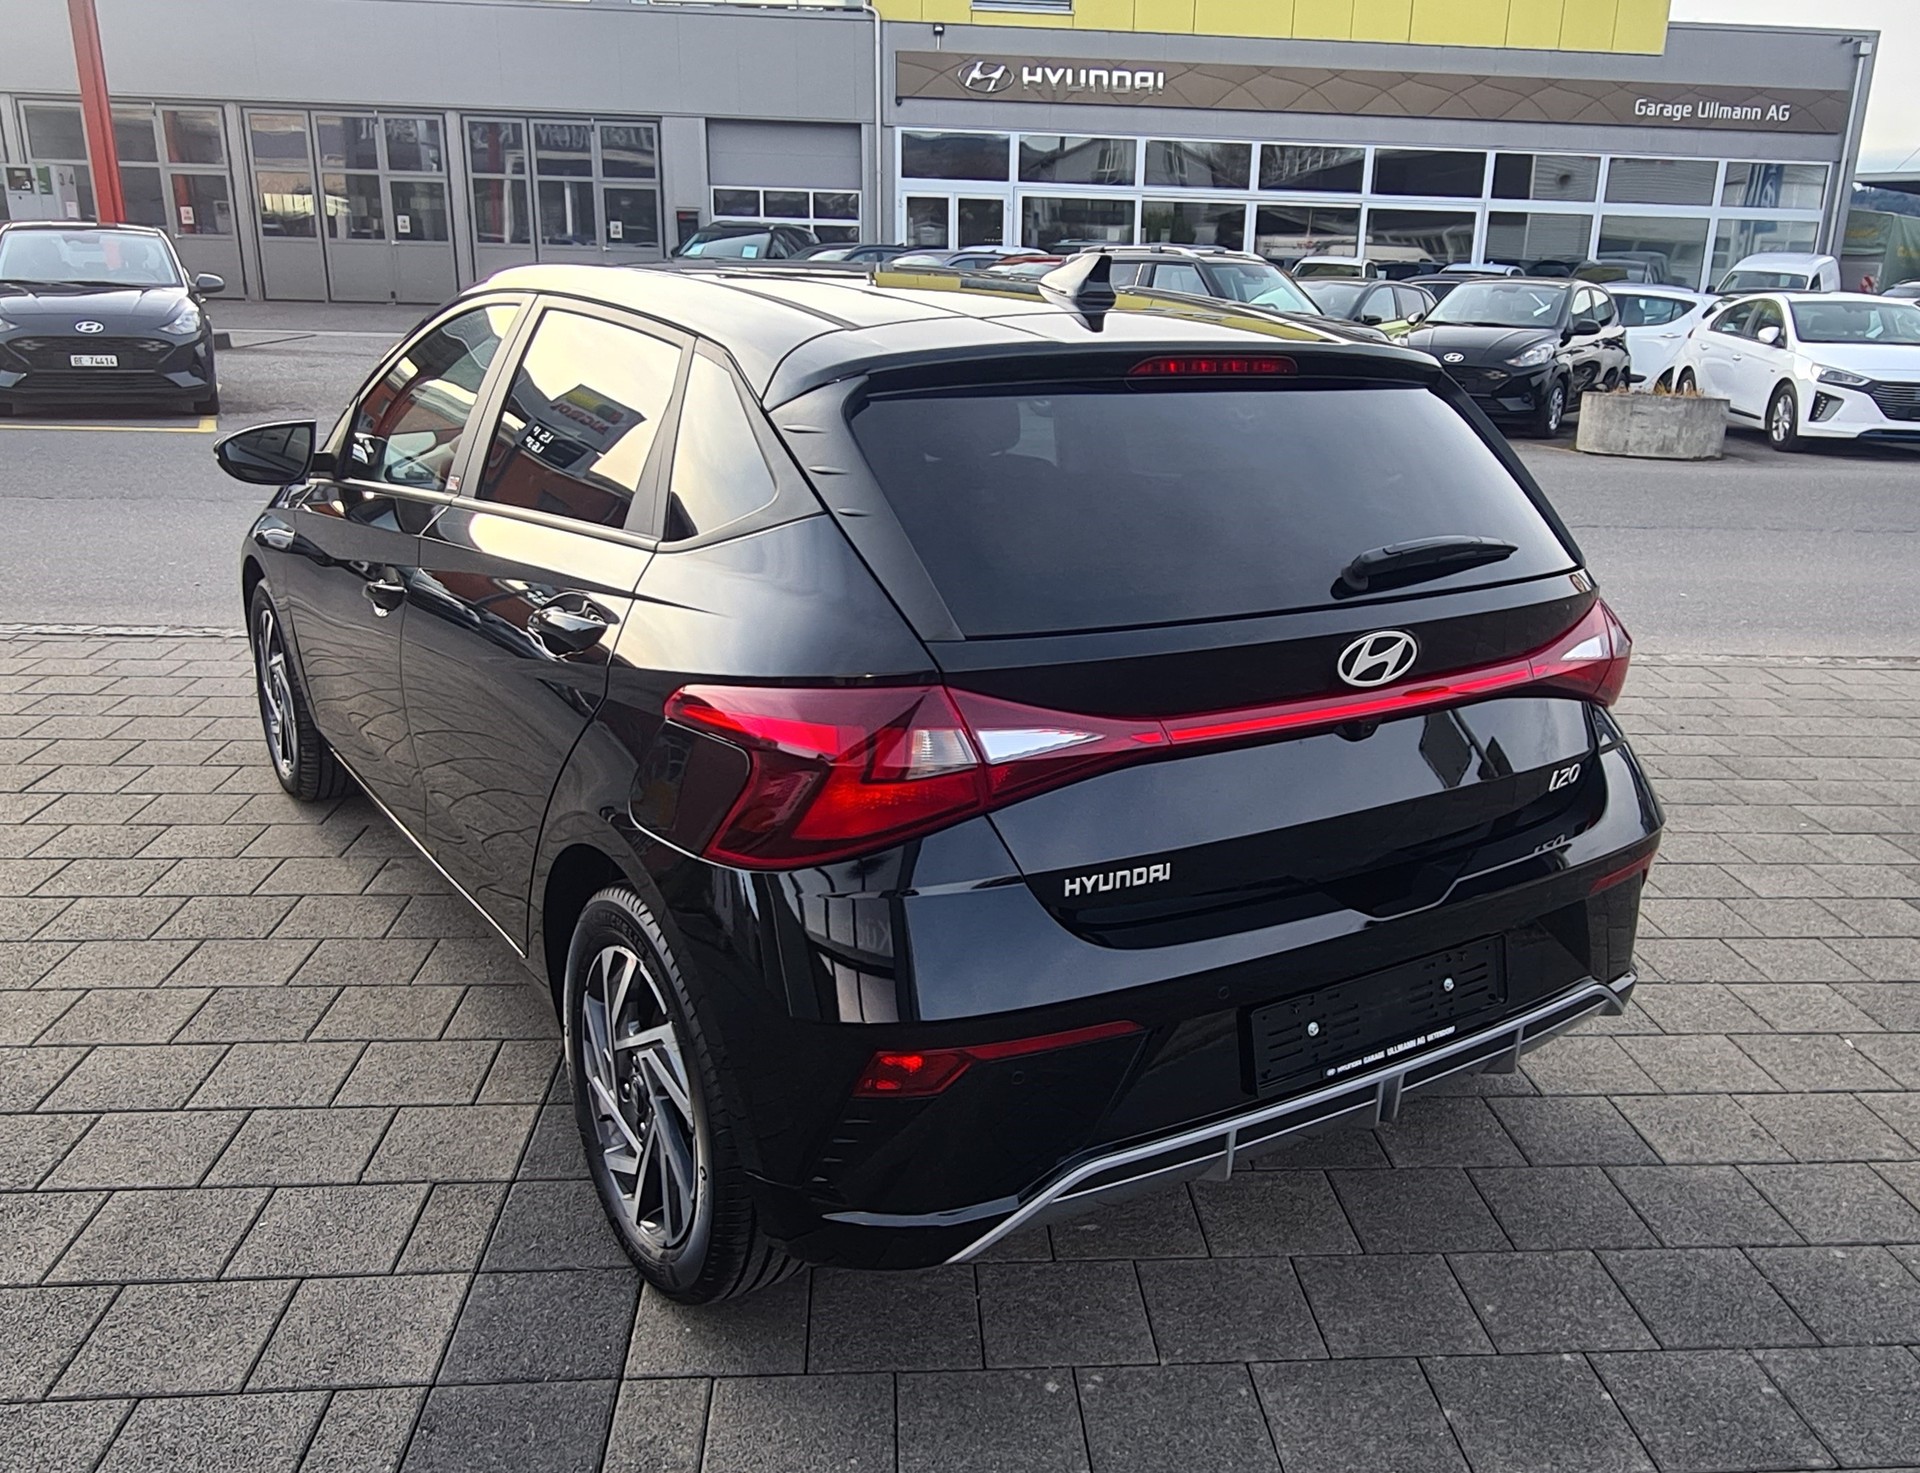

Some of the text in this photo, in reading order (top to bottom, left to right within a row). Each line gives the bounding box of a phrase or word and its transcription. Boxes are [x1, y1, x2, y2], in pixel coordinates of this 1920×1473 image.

[1022, 66, 1165, 95] HYUNDAI
[1634, 99, 1791, 121] Garage Ullmann AG
[1064, 862, 1171, 897] HYUNDAI
[1386, 1038, 1417, 1057] ULLMANN
[1416, 1035, 1426, 1047] AG
